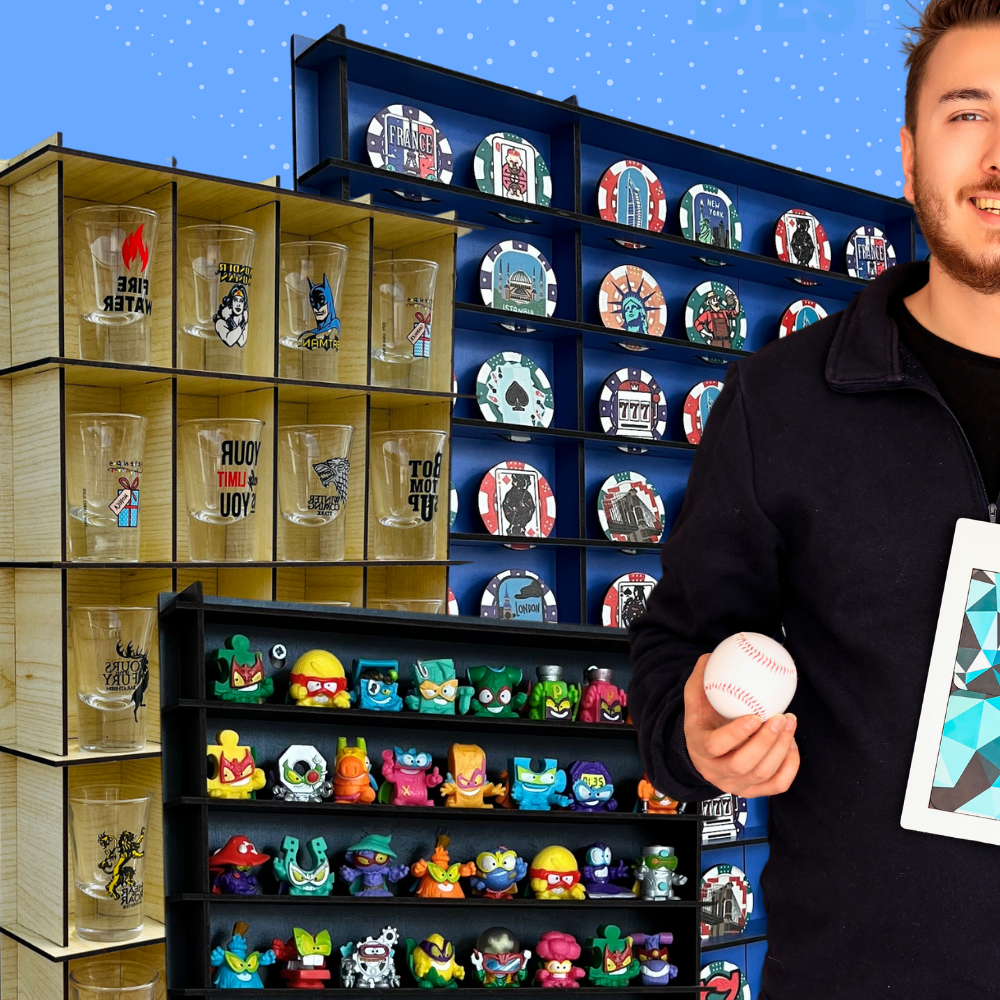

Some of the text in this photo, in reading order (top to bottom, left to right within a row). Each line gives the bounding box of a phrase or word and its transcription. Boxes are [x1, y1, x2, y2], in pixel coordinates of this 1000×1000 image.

[389, 124, 433, 154] FRANCE
[706, 198, 721, 209] NEW
[708, 207, 725, 219] YORK
[857, 243, 885, 262] FRANCE
[514, 601, 541, 618] LONDON
